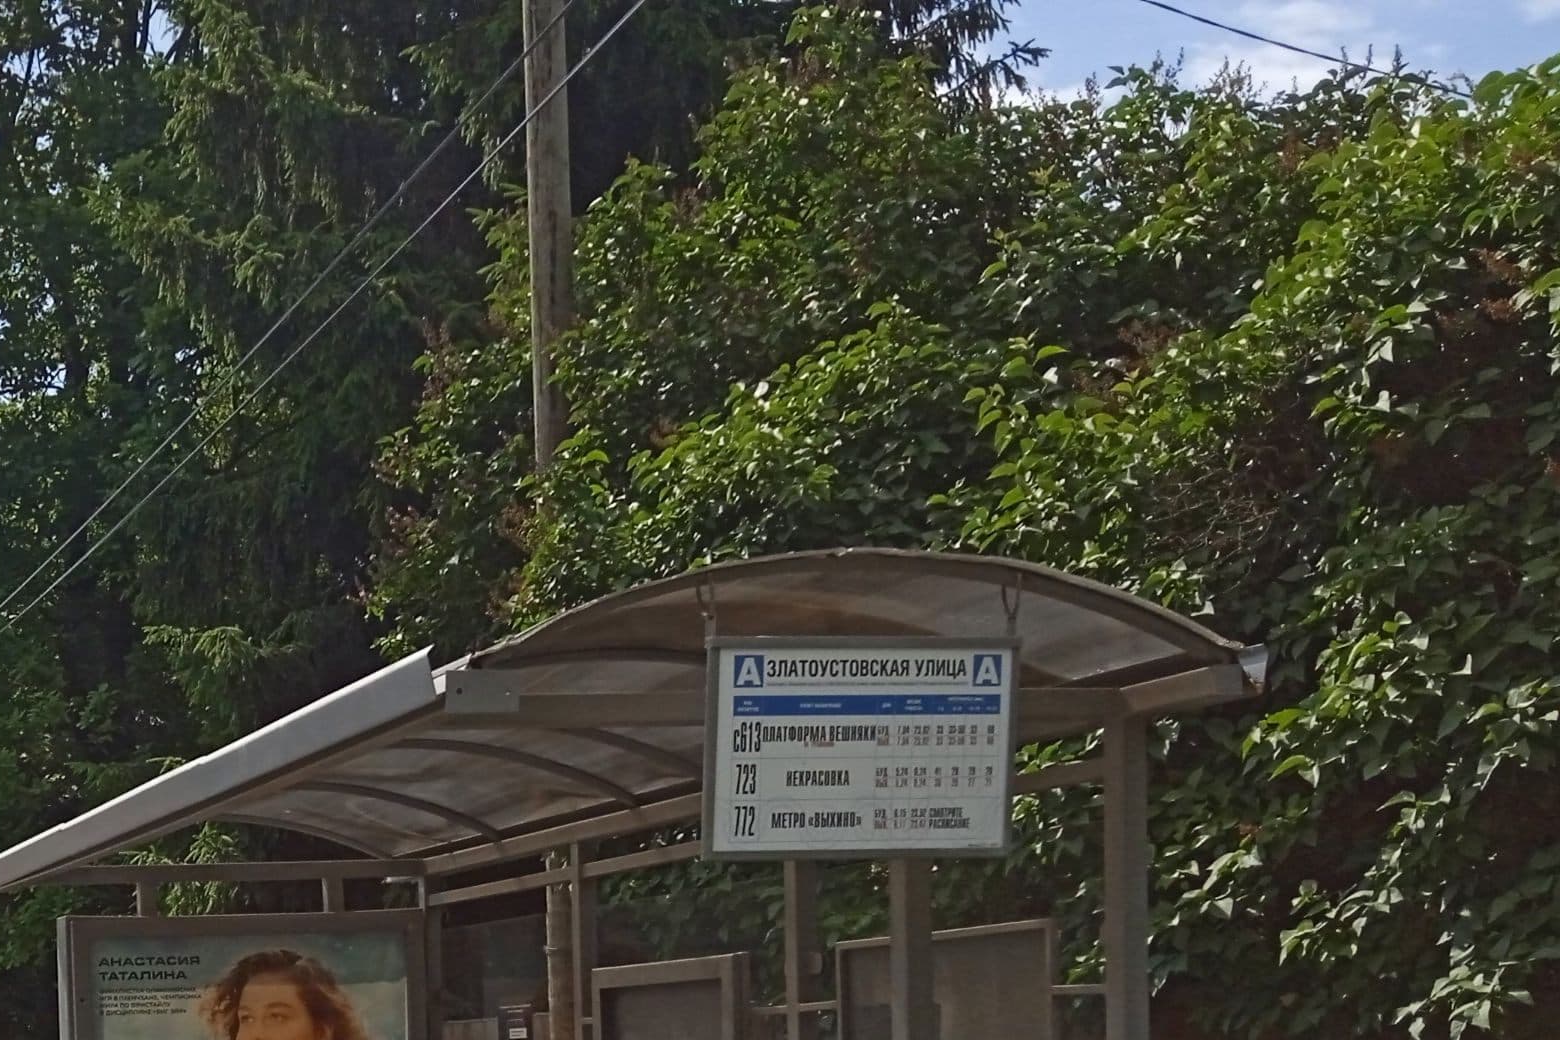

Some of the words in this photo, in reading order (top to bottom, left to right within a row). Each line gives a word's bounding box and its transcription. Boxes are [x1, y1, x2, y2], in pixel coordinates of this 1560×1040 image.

[735, 656, 762, 687] А
[766, 658, 909, 678] ЗЛАТОУСТОВСКАЯ
[914, 658, 967, 680] УЛИЦА
[974, 655, 999, 686] А
[762, 725, 827, 743] ПЛАТФОРМА
[829, 724, 877, 742] ВЕШНЯКИ
[735, 763, 757, 795] 723
[785, 769, 850, 787] НЕКРАСОВКА
[734, 805, 756, 837] 772
[771, 812, 806, 829] МЕТРО
[808, 811, 862, 828] «ВЫХИНО»
[98, 955, 201, 968] АНАСТАСИЯ
[98, 970, 188, 982] ТАТАЛИНА
